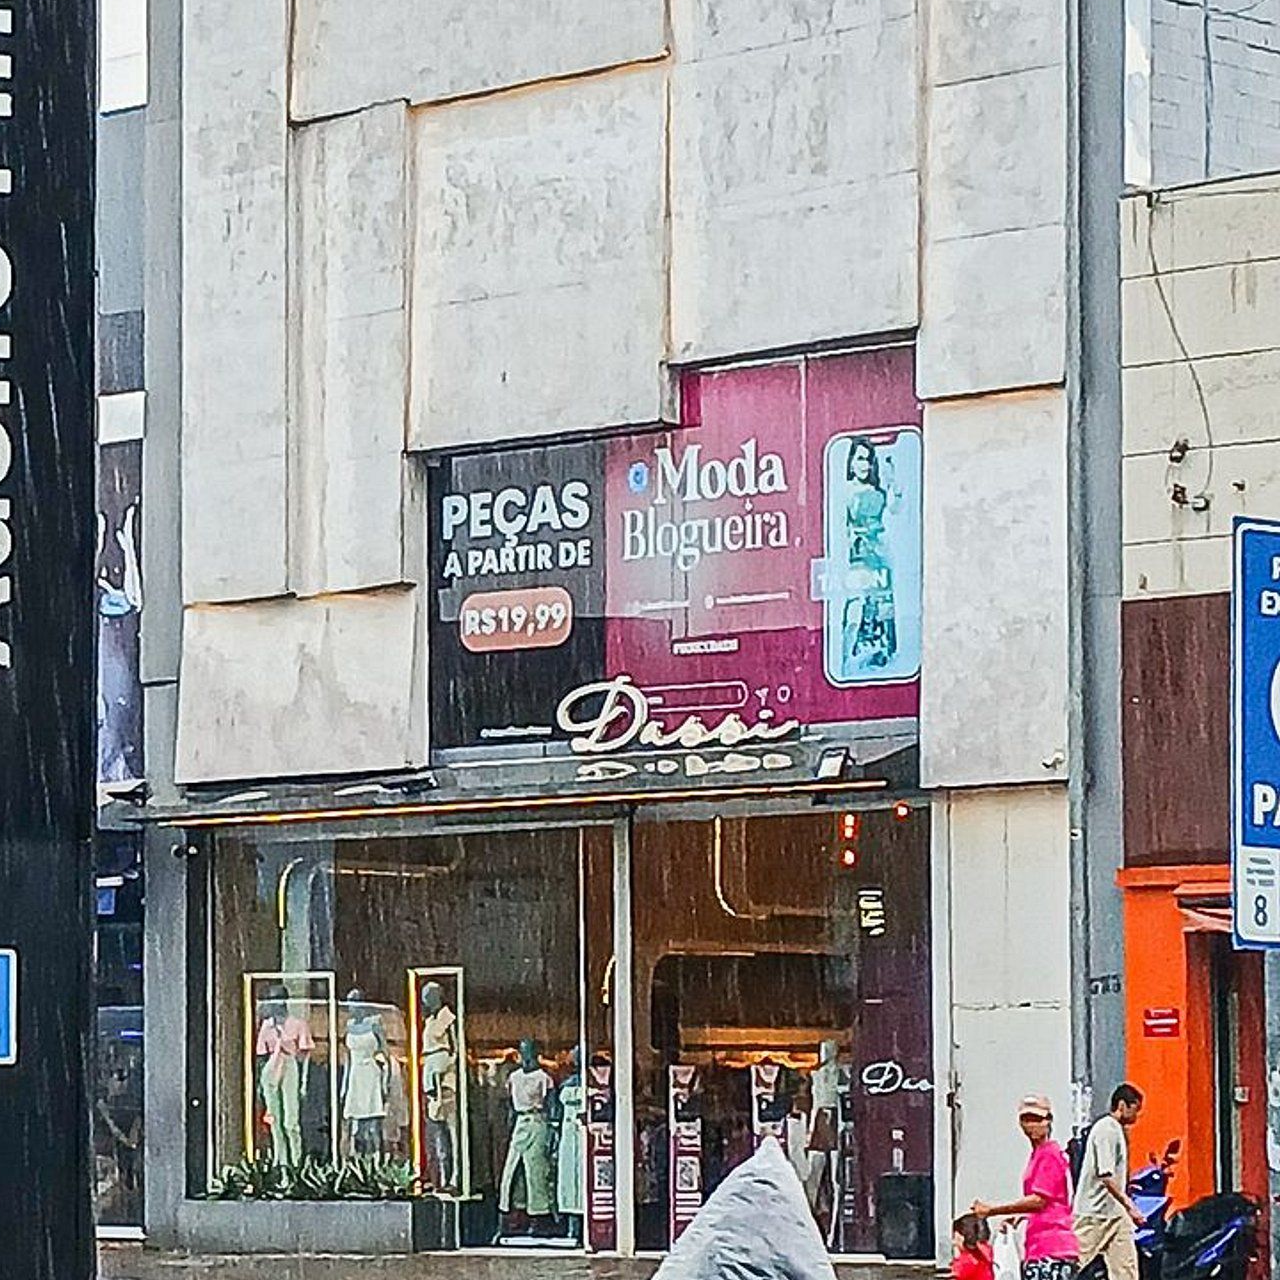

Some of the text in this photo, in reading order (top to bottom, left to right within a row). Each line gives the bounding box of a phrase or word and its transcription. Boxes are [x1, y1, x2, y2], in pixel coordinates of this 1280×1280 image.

[653, 438, 789, 504] Moda
[442, 481, 590, 548] PEÇAS
[622, 498, 788, 572] Blogueira
[443, 539, 591, 578] A PARTIR DE
[1260, 590, 1280, 616] E
[862, 1060, 934, 1095] Das
